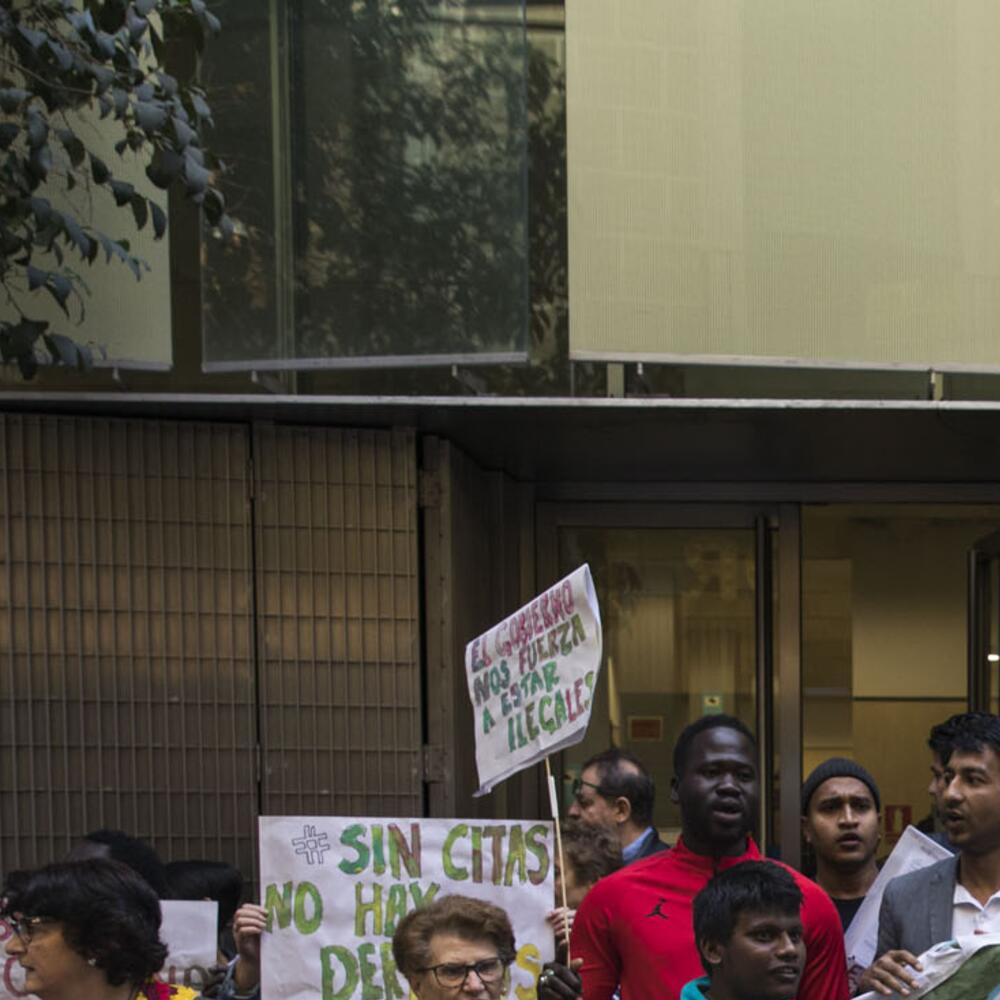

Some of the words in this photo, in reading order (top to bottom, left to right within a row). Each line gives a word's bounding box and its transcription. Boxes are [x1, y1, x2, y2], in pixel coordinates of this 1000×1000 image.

[471, 635, 493, 673] EL
[473, 659, 511, 707] NOS
[518, 613, 586, 676] FUERZA
[482, 705, 497, 735] A
[500, 660, 560, 718] ESTAR
[441, 823, 550, 887] CITAS
[265, 881, 324, 936] NO
